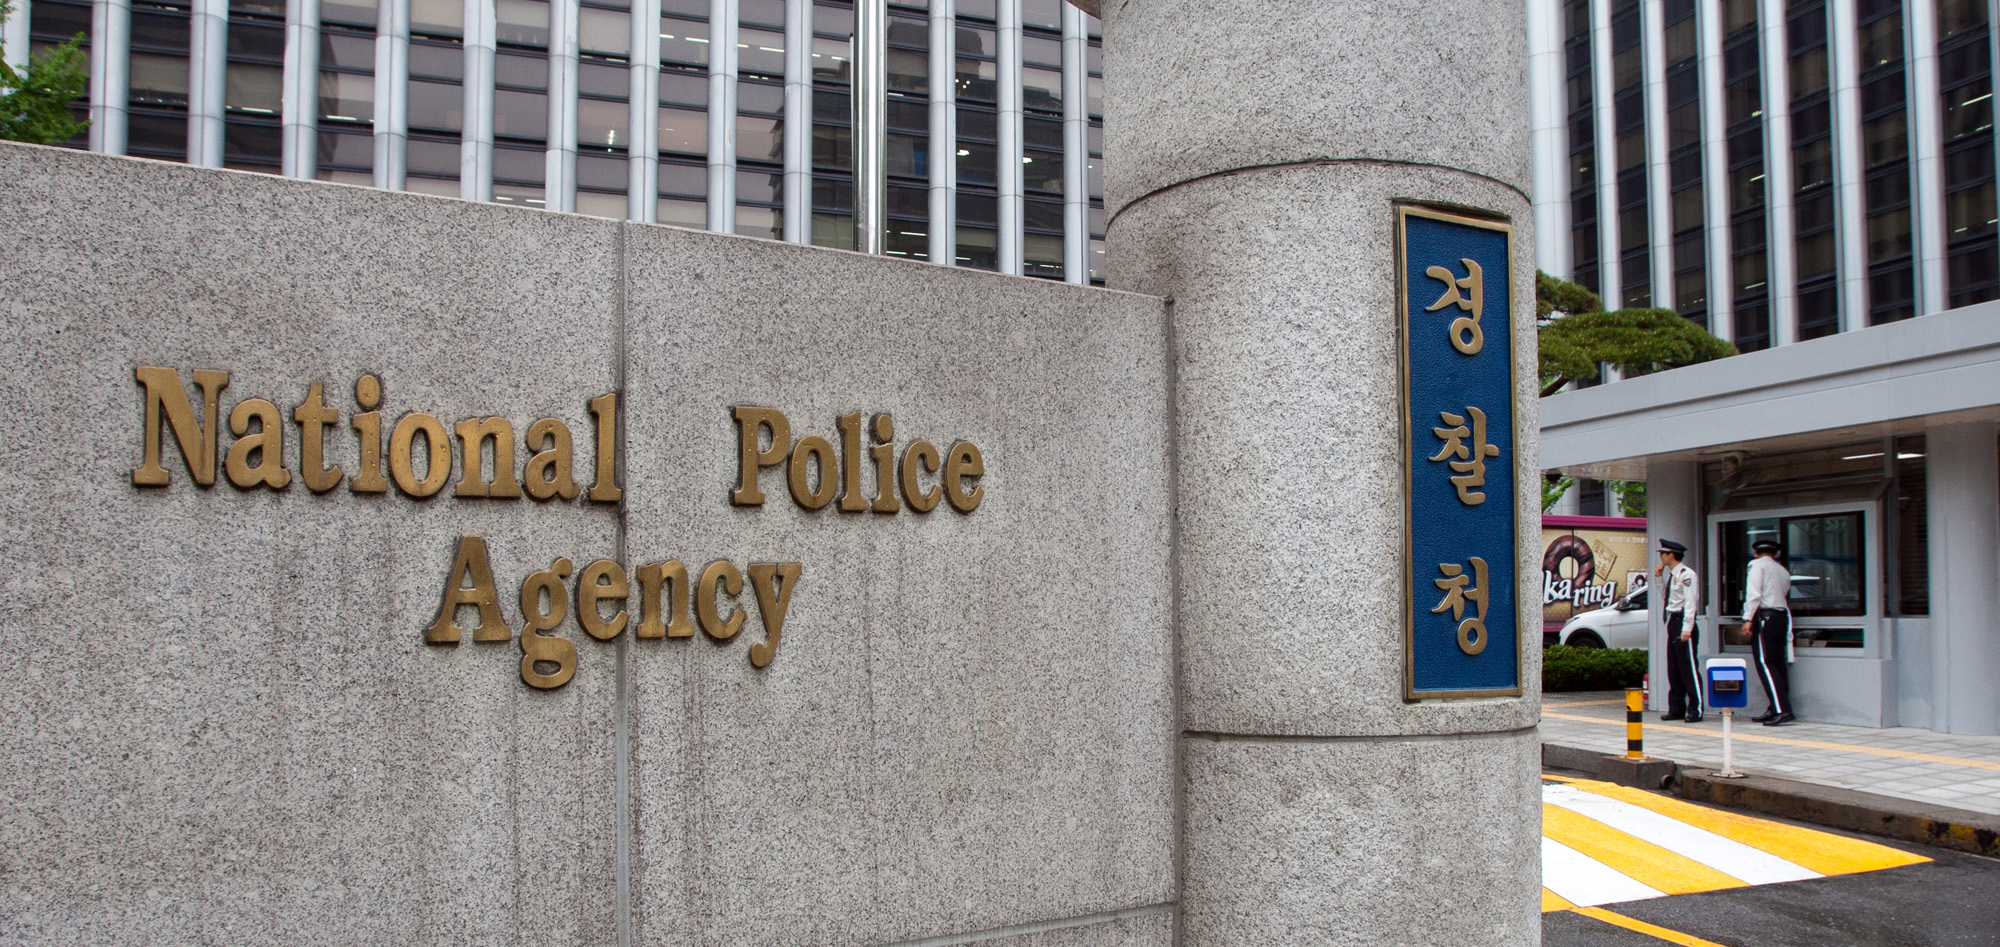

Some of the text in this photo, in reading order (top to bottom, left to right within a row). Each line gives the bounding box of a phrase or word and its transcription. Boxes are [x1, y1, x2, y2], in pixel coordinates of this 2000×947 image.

[132, 366, 985, 513] National Police
[1425, 257, 1500, 656] 경찰청
[425, 535, 802, 689] Agency
